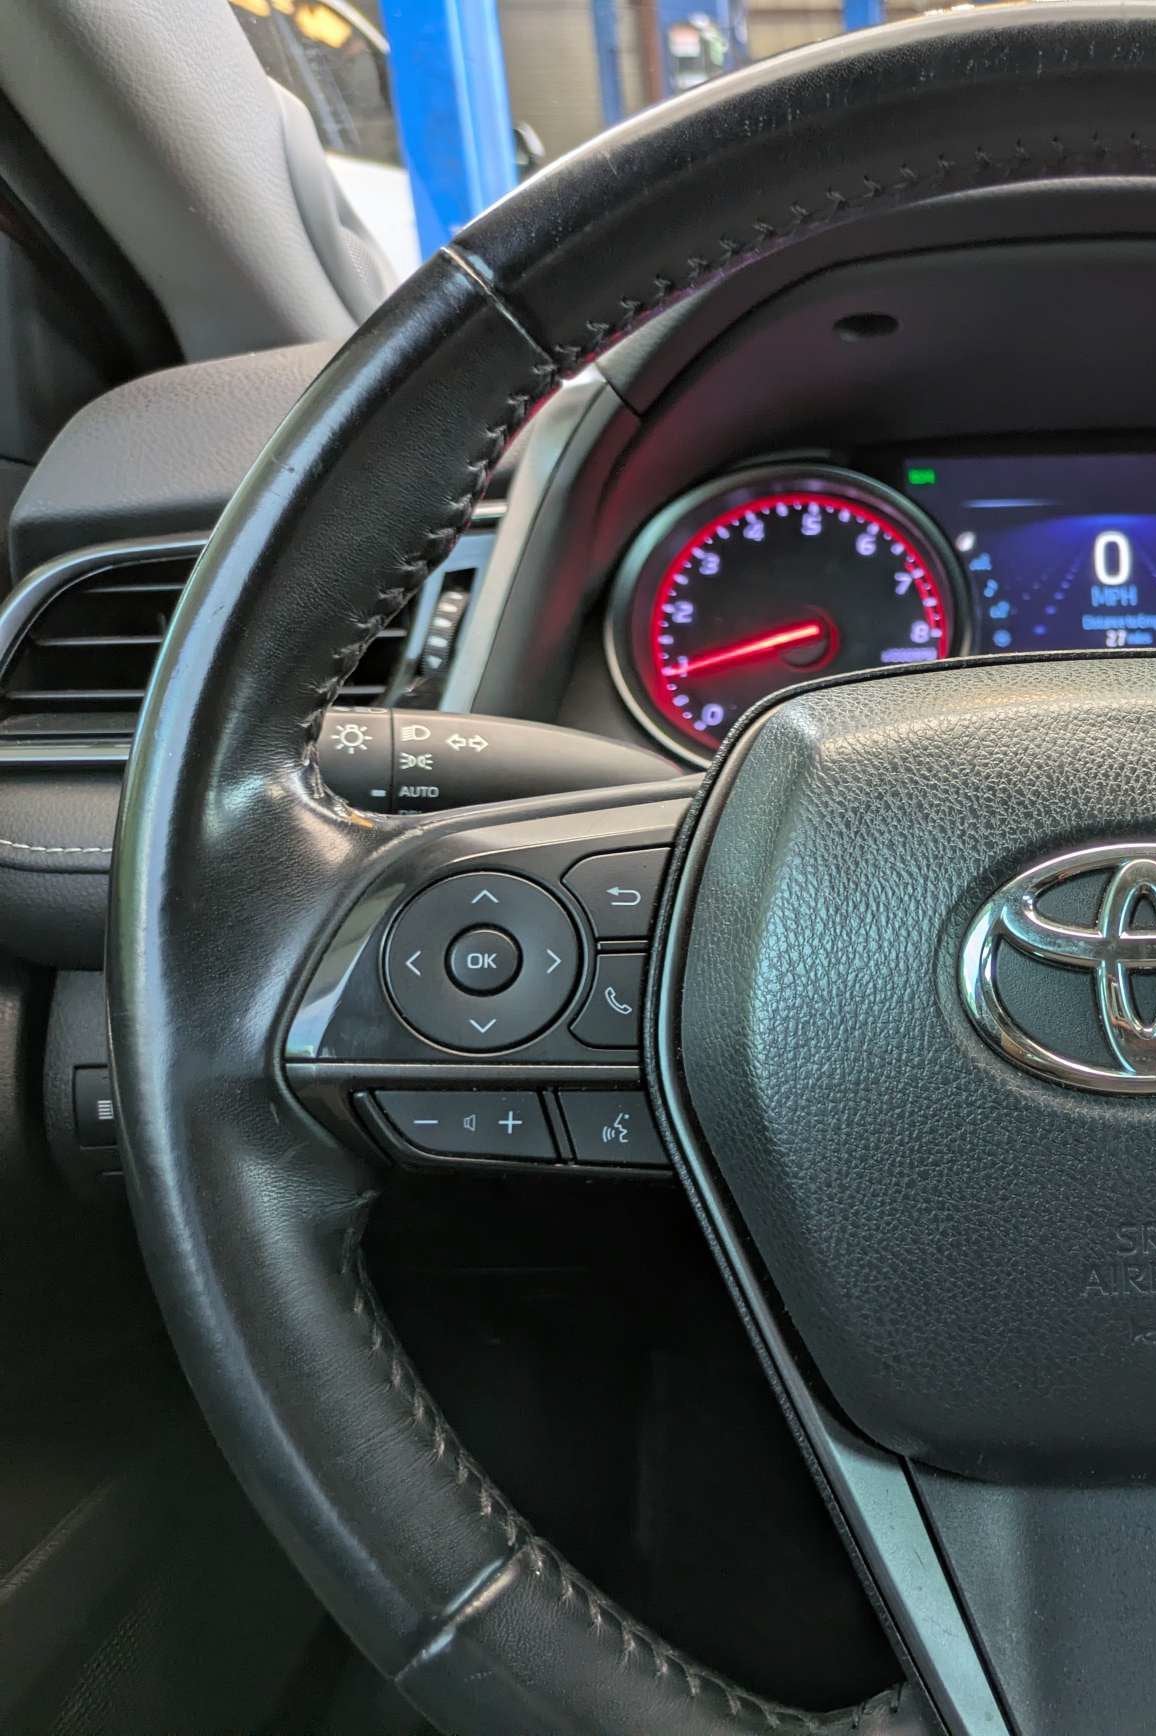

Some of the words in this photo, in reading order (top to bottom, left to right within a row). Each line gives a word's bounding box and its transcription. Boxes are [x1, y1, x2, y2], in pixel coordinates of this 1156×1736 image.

[801, 512, 822, 536] 5
[855, 534, 877, 556] 6
[700, 552, 721, 576] 3
[1093, 530, 1131, 585] 0
[894, 572, 913, 595] 7
[672, 601, 694, 623] 2
[910, 620, 930, 644] 8
[702, 703, 724, 726] 0
[399, 785, 439, 798] AUTO
[467, 953, 497, 969] OK
